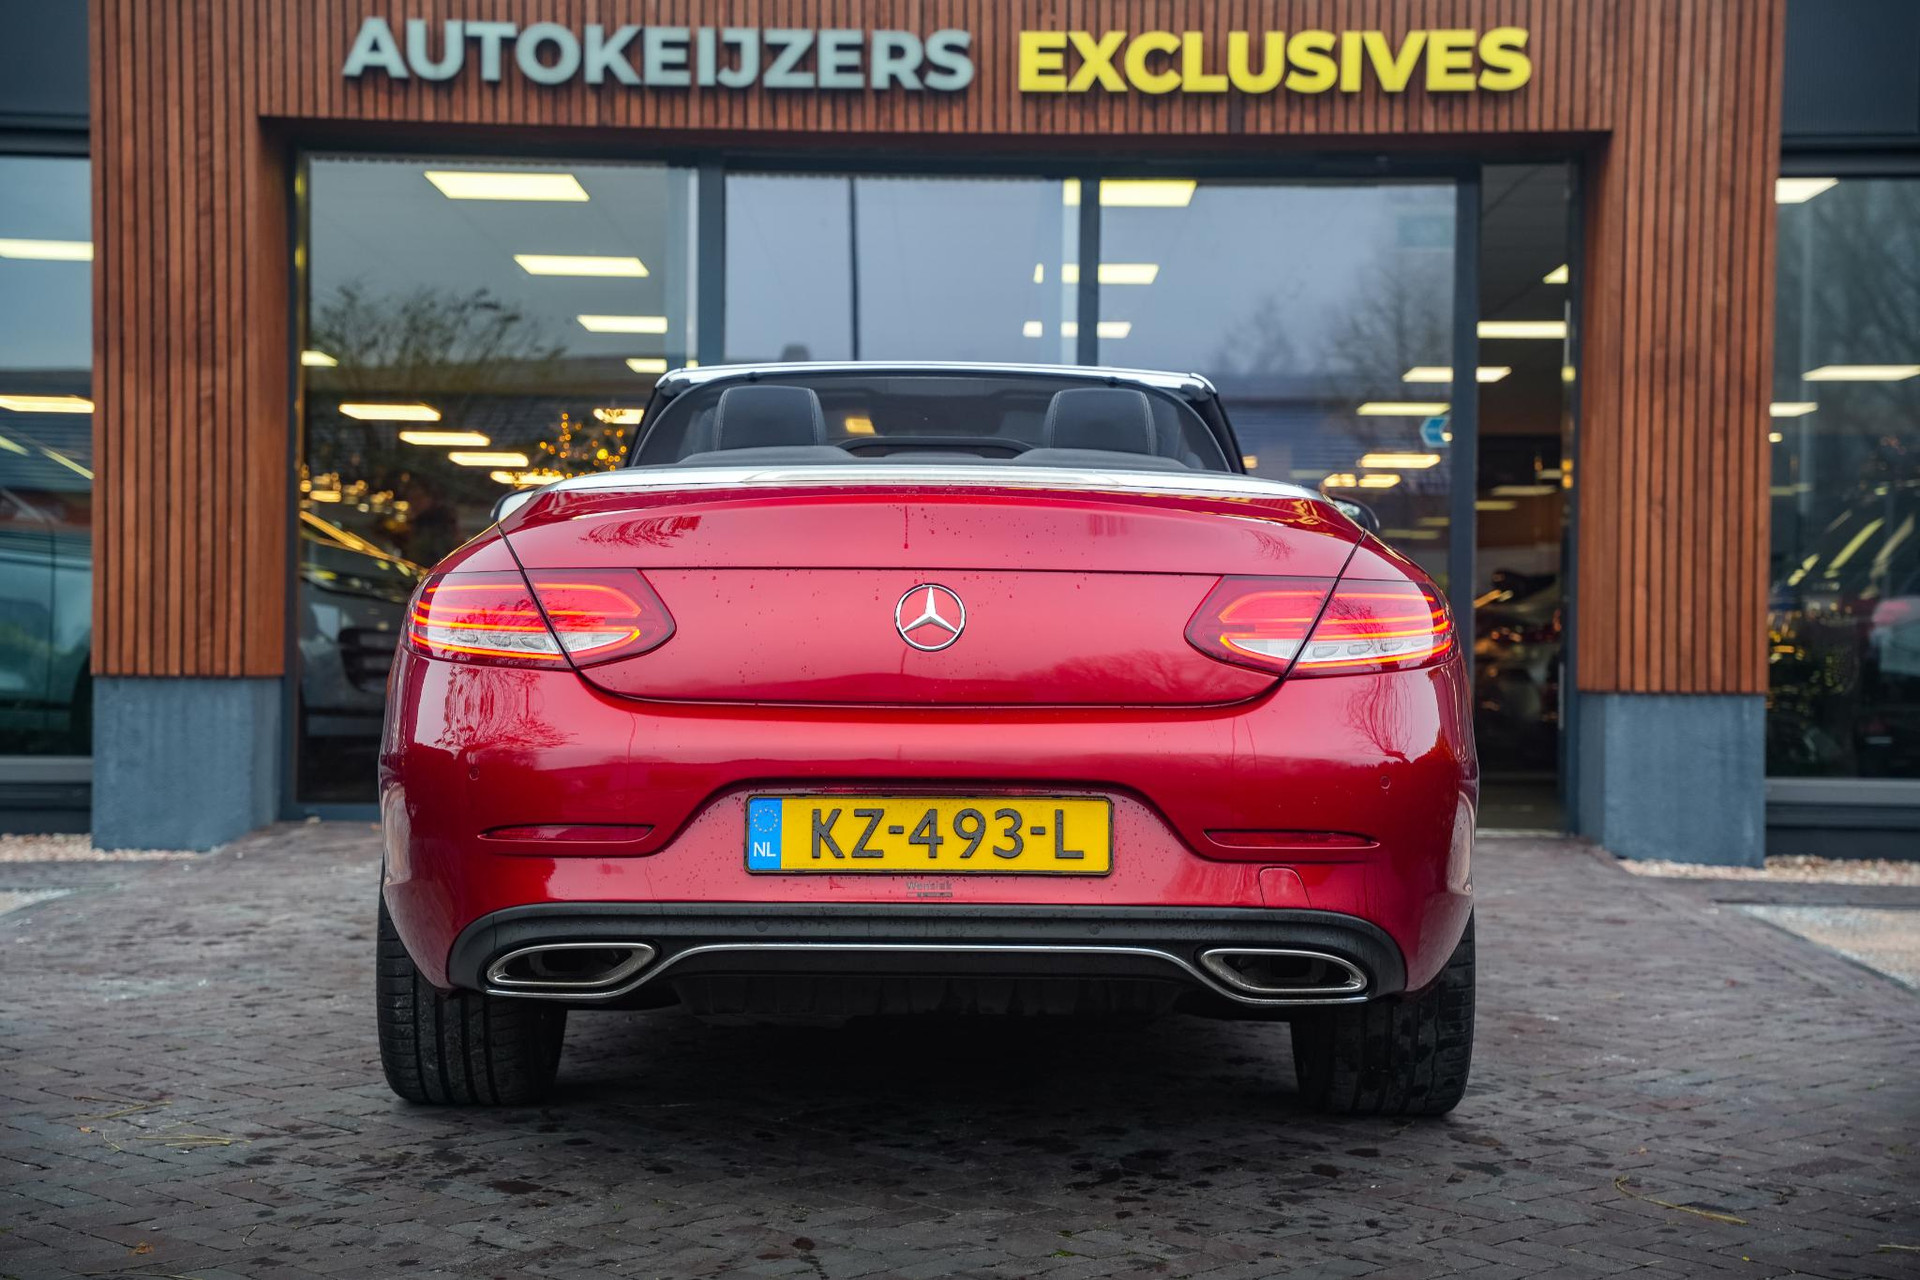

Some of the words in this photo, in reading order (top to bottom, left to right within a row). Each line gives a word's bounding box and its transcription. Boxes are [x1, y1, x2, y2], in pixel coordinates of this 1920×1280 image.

[342, 17, 975, 91] AUTOKEIJZERS
[1019, 28, 1532, 93] EXCLUSIVES
[753, 842, 776, 857] NL
[811, 808, 1085, 860] KZ-493-L
